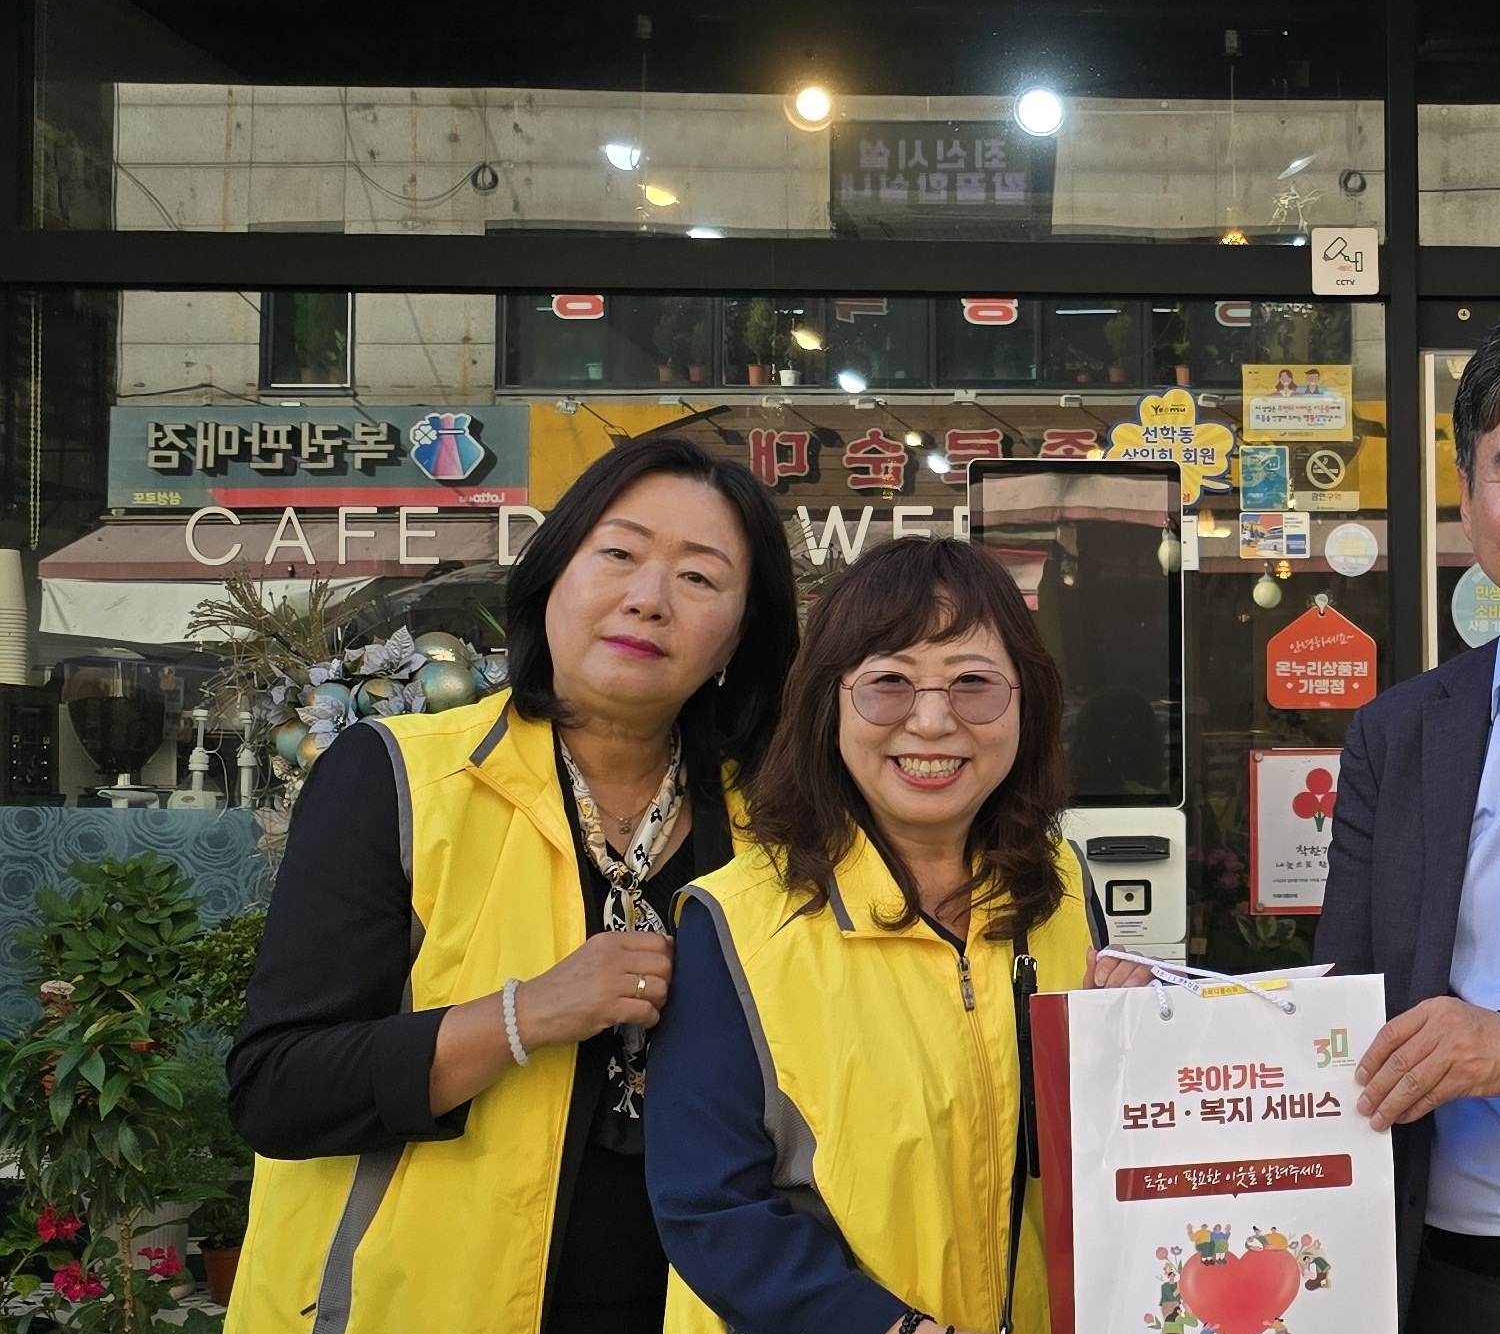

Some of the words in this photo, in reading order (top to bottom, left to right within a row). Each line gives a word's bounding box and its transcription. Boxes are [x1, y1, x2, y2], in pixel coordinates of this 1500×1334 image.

[1150, 404, 1187, 416] Yeonsu
[1142, 425, 1195, 444] 선학동
[1181, 447, 1216, 466] 회원
[1311, 492, 1342, 502] 금연구역
[185, 506, 440, 566] CAFE
[1275, 661, 1369, 677] 온누리상품권
[1298, 679, 1346, 695] 가맹점
[1177, 1062, 1285, 1094] 찾아가는
[1122, 1100, 1177, 1130] 보건
[1199, 1095, 1253, 1125] 복지
[1261, 1091, 1342, 1121] 서비스
[1143, 1171, 1178, 1192] 도움이
[1182, 1167, 1222, 1191] 필요한
[1225, 1165, 1258, 1189] 이웃을
[1261, 1163, 1325, 1184] 알려주세요
